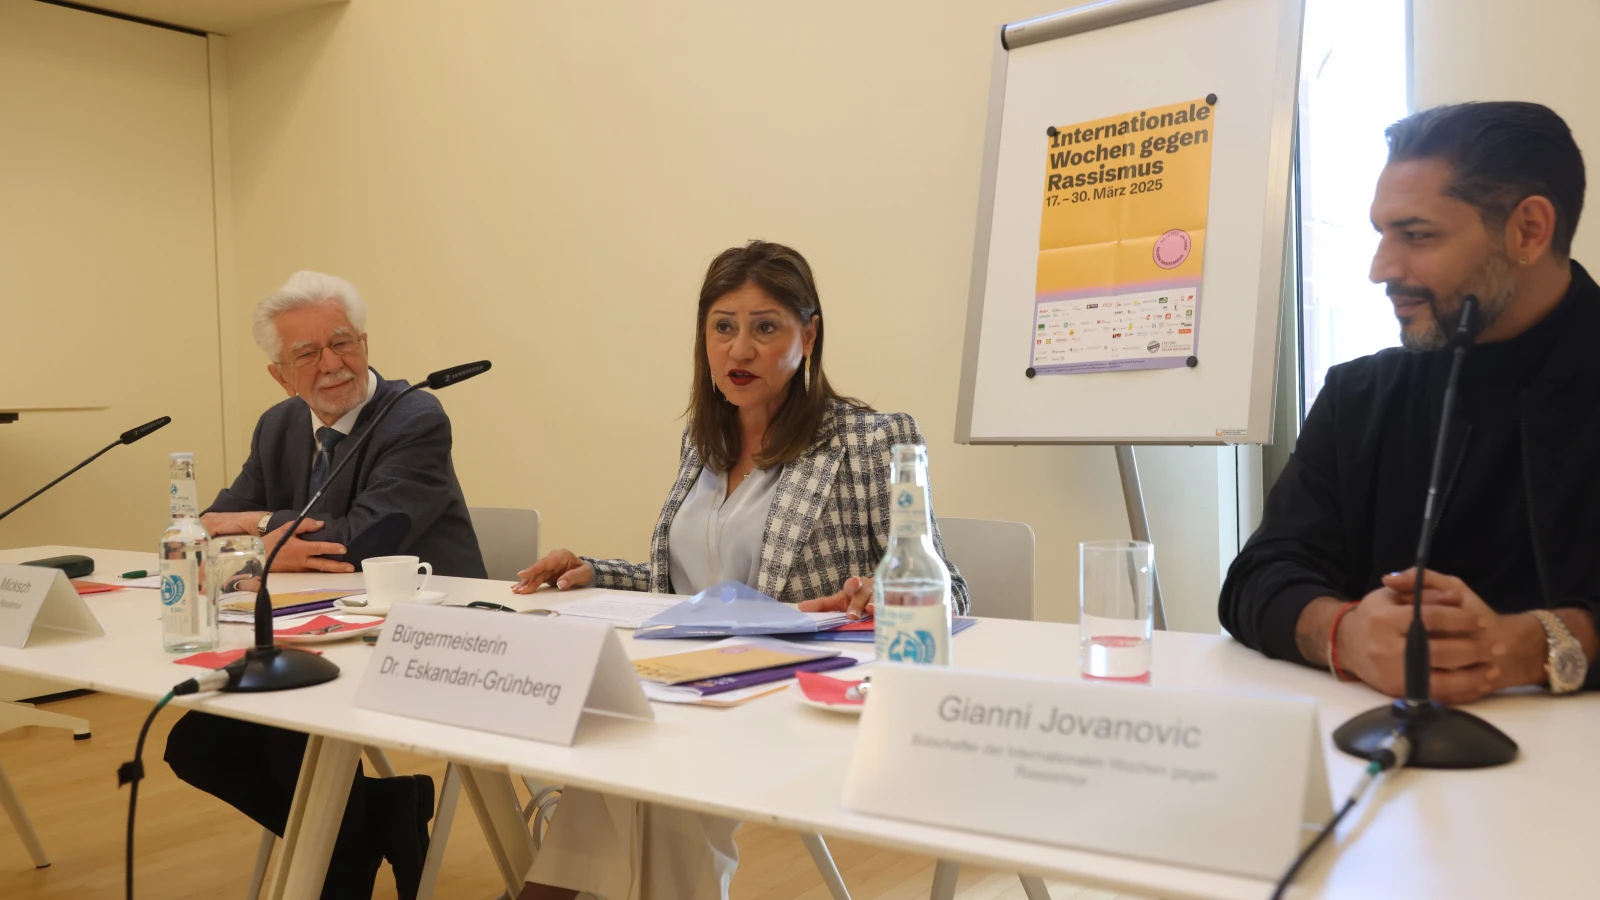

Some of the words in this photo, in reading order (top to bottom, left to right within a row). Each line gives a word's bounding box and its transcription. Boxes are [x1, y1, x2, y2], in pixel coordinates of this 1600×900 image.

[1051, 103, 1211, 149] Internationale
[1050, 141, 1136, 170] Wochen
[1139, 128, 1209, 158] gegen
[1047, 159, 1164, 192] Rassismus
[1093, 185, 1126, 200] März
[1129, 178, 1163, 195] 2025
[391, 623, 508, 656] Bürgermeisterin
[380, 656, 399, 676] Dr.
[404, 658, 562, 706] Eskandari-Grünberg
[937, 694, 1033, 732] Gianni
[1038, 705, 1202, 750] Jovanovic
